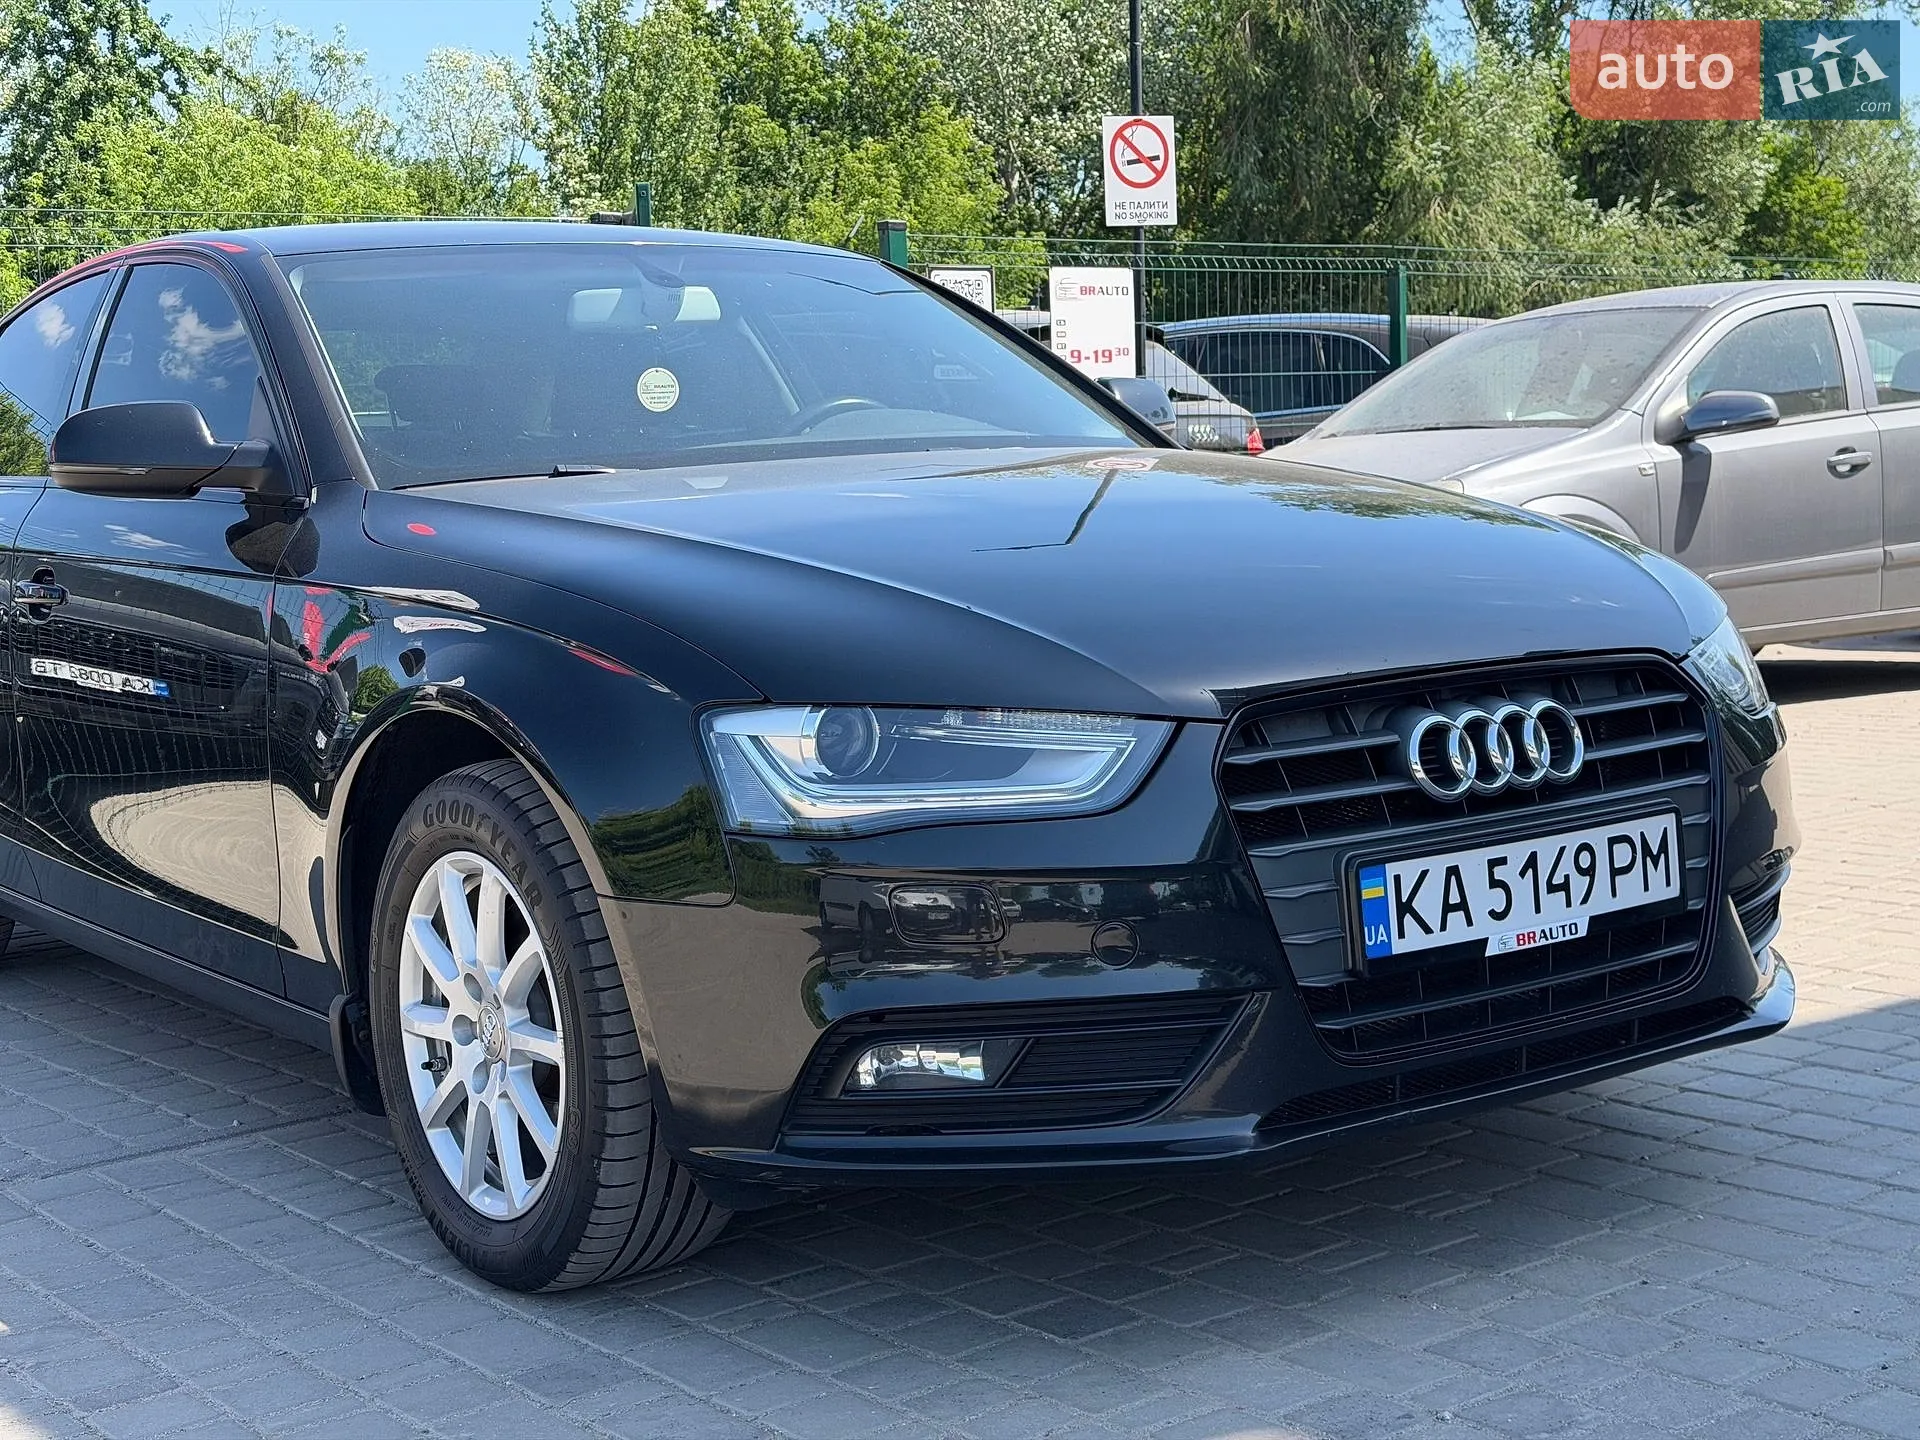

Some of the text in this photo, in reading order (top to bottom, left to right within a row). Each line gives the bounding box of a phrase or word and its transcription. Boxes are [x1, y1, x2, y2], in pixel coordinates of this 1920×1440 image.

[1114, 201, 1168, 210] НЕ ПАЛИТИ
[1114, 211, 1168, 220] NO SMOKING
[1080, 285, 1129, 296] BRAUTO
[423, 799, 543, 909] GOODYEAR
[1364, 826, 1671, 946] UA KA 5149 PM
[1515, 922, 1578, 947] BRAUTO
